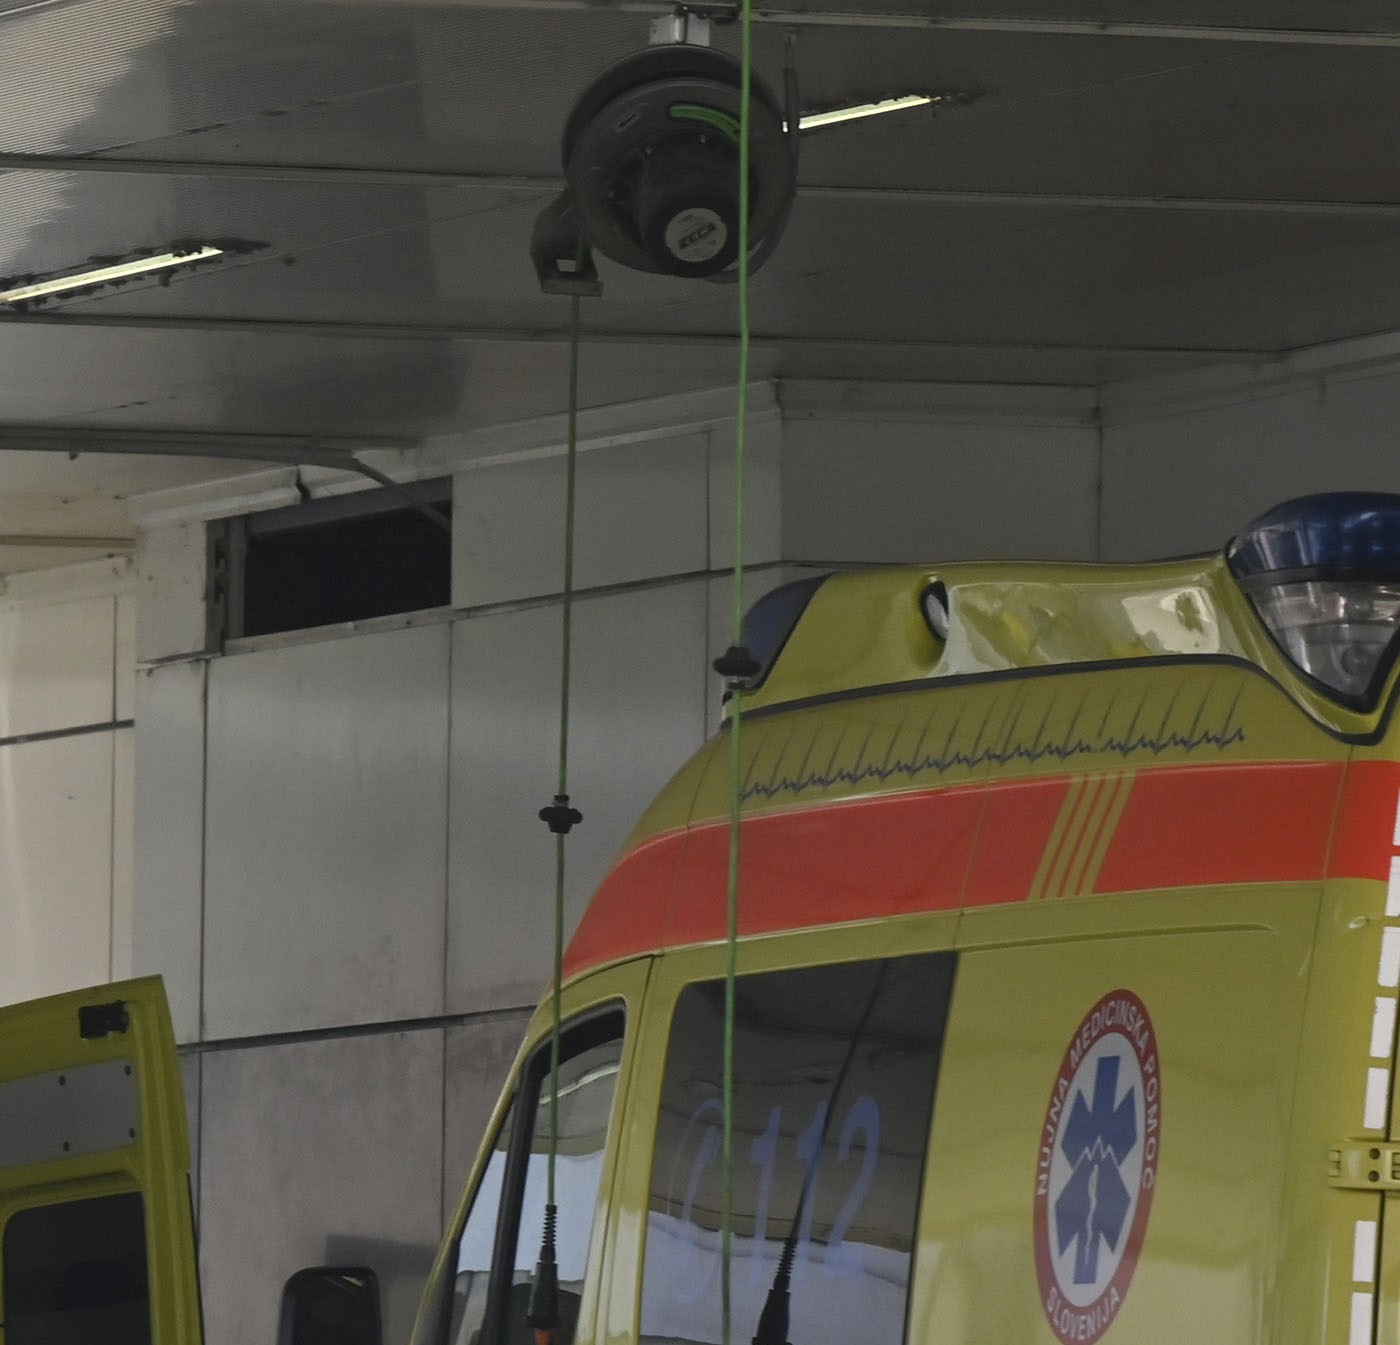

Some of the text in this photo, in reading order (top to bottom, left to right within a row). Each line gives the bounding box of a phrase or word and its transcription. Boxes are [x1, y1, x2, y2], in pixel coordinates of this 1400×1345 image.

[751, 1096, 881, 1282] 112
[1037, 999, 1160, 1196] NUJNA MEDICINSKA POMOČ
[1046, 1286, 1120, 1341] SLOVENIJA
